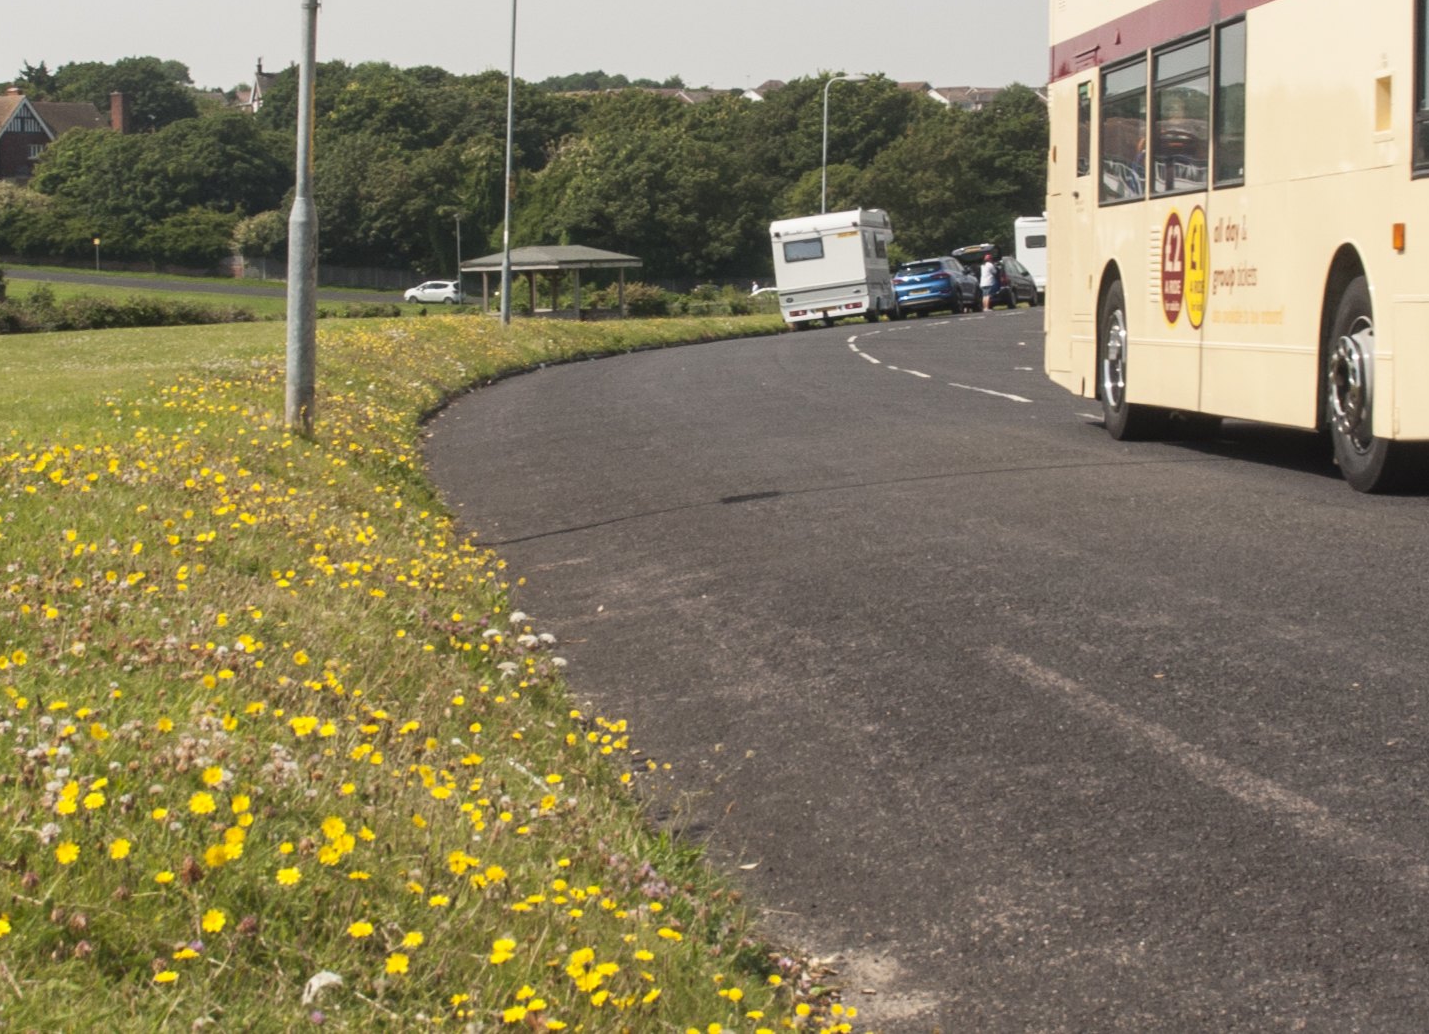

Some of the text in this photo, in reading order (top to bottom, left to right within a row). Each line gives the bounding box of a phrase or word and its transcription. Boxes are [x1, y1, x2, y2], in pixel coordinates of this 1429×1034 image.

[1163, 223, 1183, 272] £2
[1189, 223, 1205, 271] £1
[1225, 215, 1240, 251] day
[1212, 266, 1236, 296] group
